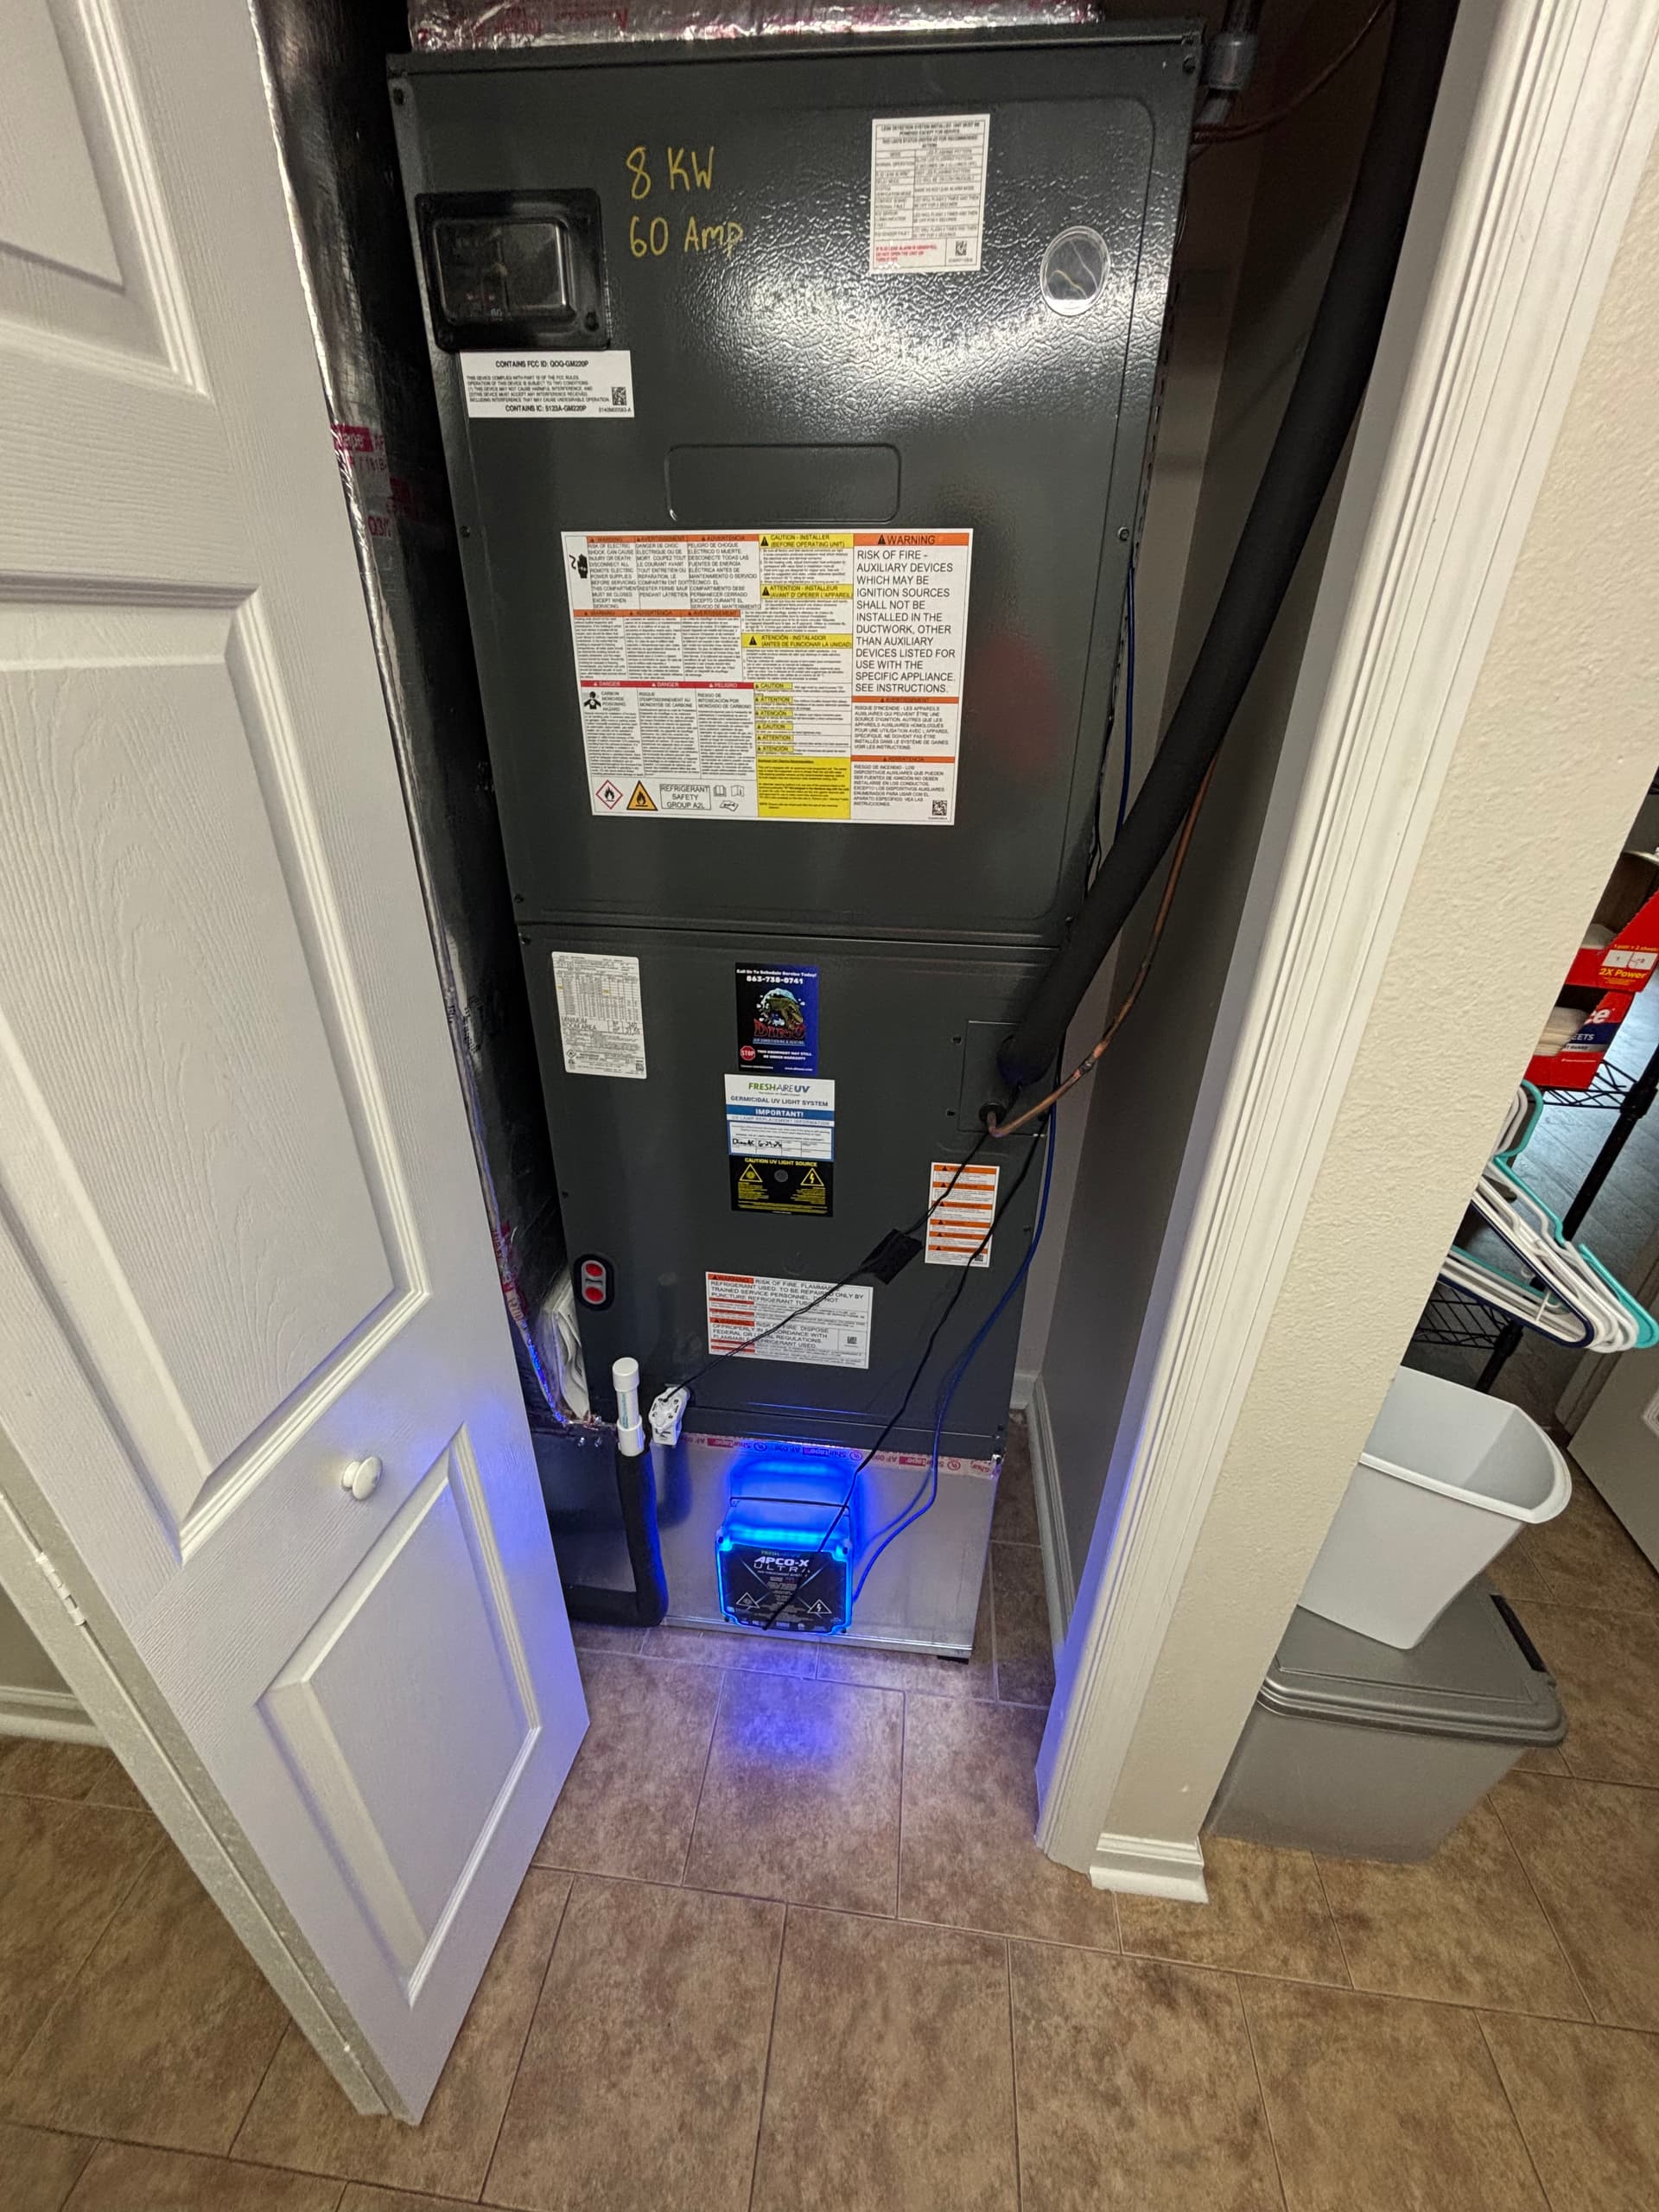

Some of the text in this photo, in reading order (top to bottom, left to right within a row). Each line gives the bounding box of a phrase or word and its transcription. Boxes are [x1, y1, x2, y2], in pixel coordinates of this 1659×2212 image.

[626, 146, 715, 200] 8 KW
[630, 215, 744, 260] 60 Amp
[887, 536, 935, 544] WARNING
[857, 550, 880, 559] RISK
[882, 550, 896, 559] OF
[899, 550, 921, 559] FIRE
[857, 563, 953, 572] AUXILIARY DEVICES
[857, 575, 929, 584] WHICH MAY BE
[857, 588, 950, 597] IGNITION SOURCES
[857, 601, 925, 609] SHALL NOT BE
[857, 613, 943, 621] INSTALLED IN THE
[856, 625, 951, 634] DUCTWORK, OTHER
[855, 637, 933, 645] THAN AUXILIARY
[855, 649, 956, 658] DEVICES LISTED FOR
[855, 660, 923, 669] USE WITH THE
[855, 672, 956, 681] SPECIFIC APPLIANCE.
[855, 683, 948, 693] SEE INSTRUCTIONS.
[660, 785, 709, 793] REFRIGERANT
[1599, 968, 1647, 979] 2X Power
[711, 1281, 756, 1290] REFRIGERANT
[748, 1295, 793, 1305] REFRIGERANT
[753, 1556, 810, 1567] APCO-X
